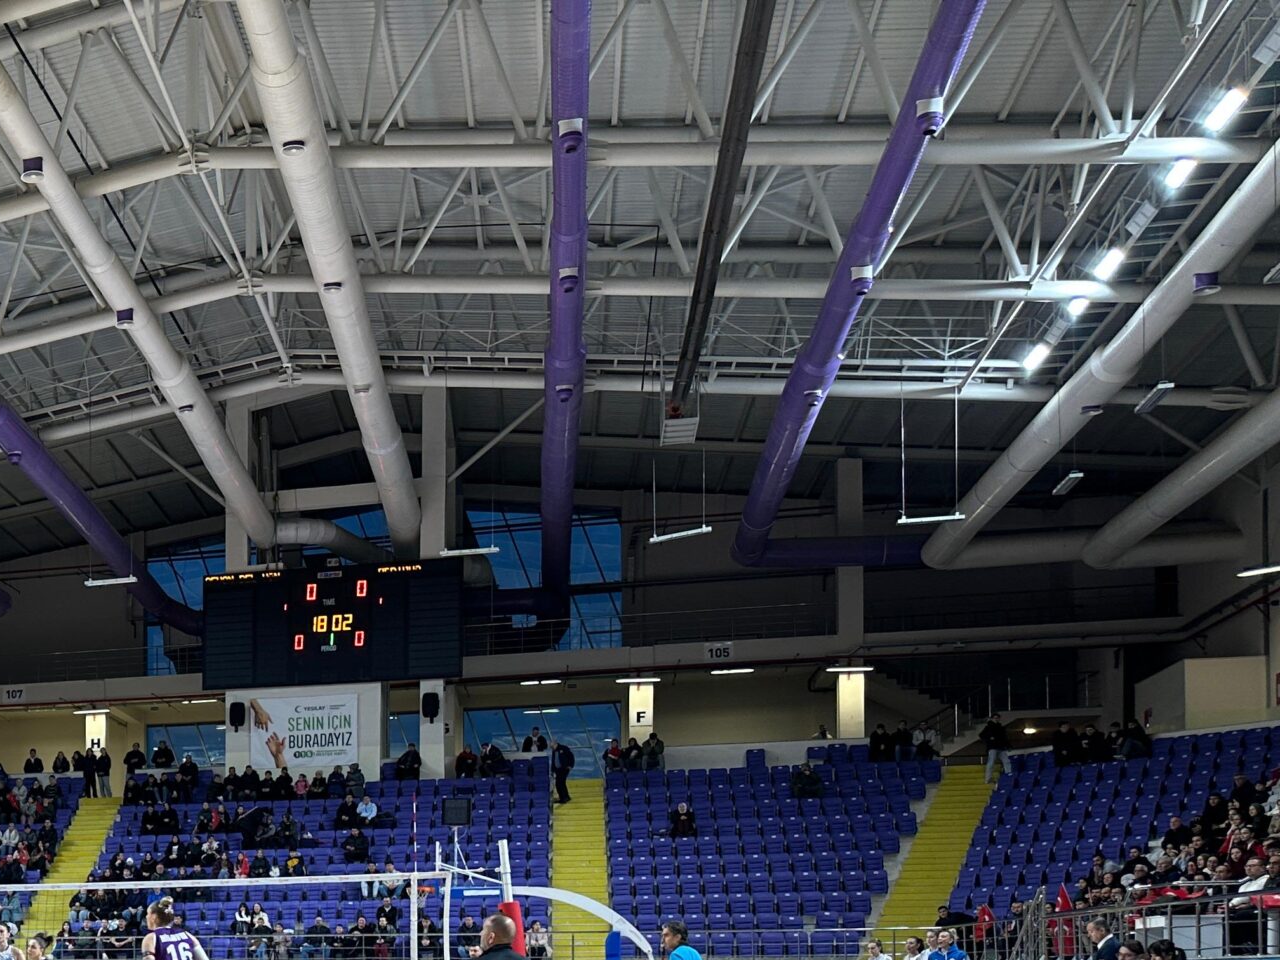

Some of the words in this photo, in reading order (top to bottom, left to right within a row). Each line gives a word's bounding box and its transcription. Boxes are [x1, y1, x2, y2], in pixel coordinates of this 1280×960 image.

[306, 584, 317, 600] 0
[357, 580, 367, 597] 0
[294, 634, 304, 650] 0
[354, 631, 365, 646] 0
[708, 648, 730, 658] 105
[6, 690, 23, 699] 107
[288, 714, 324, 731] SENİN
[327, 712, 351, 731] İÇİN
[636, 712, 646, 723] F
[91, 738, 101, 748] H
[289, 732, 352, 749] BURADAYIZ
